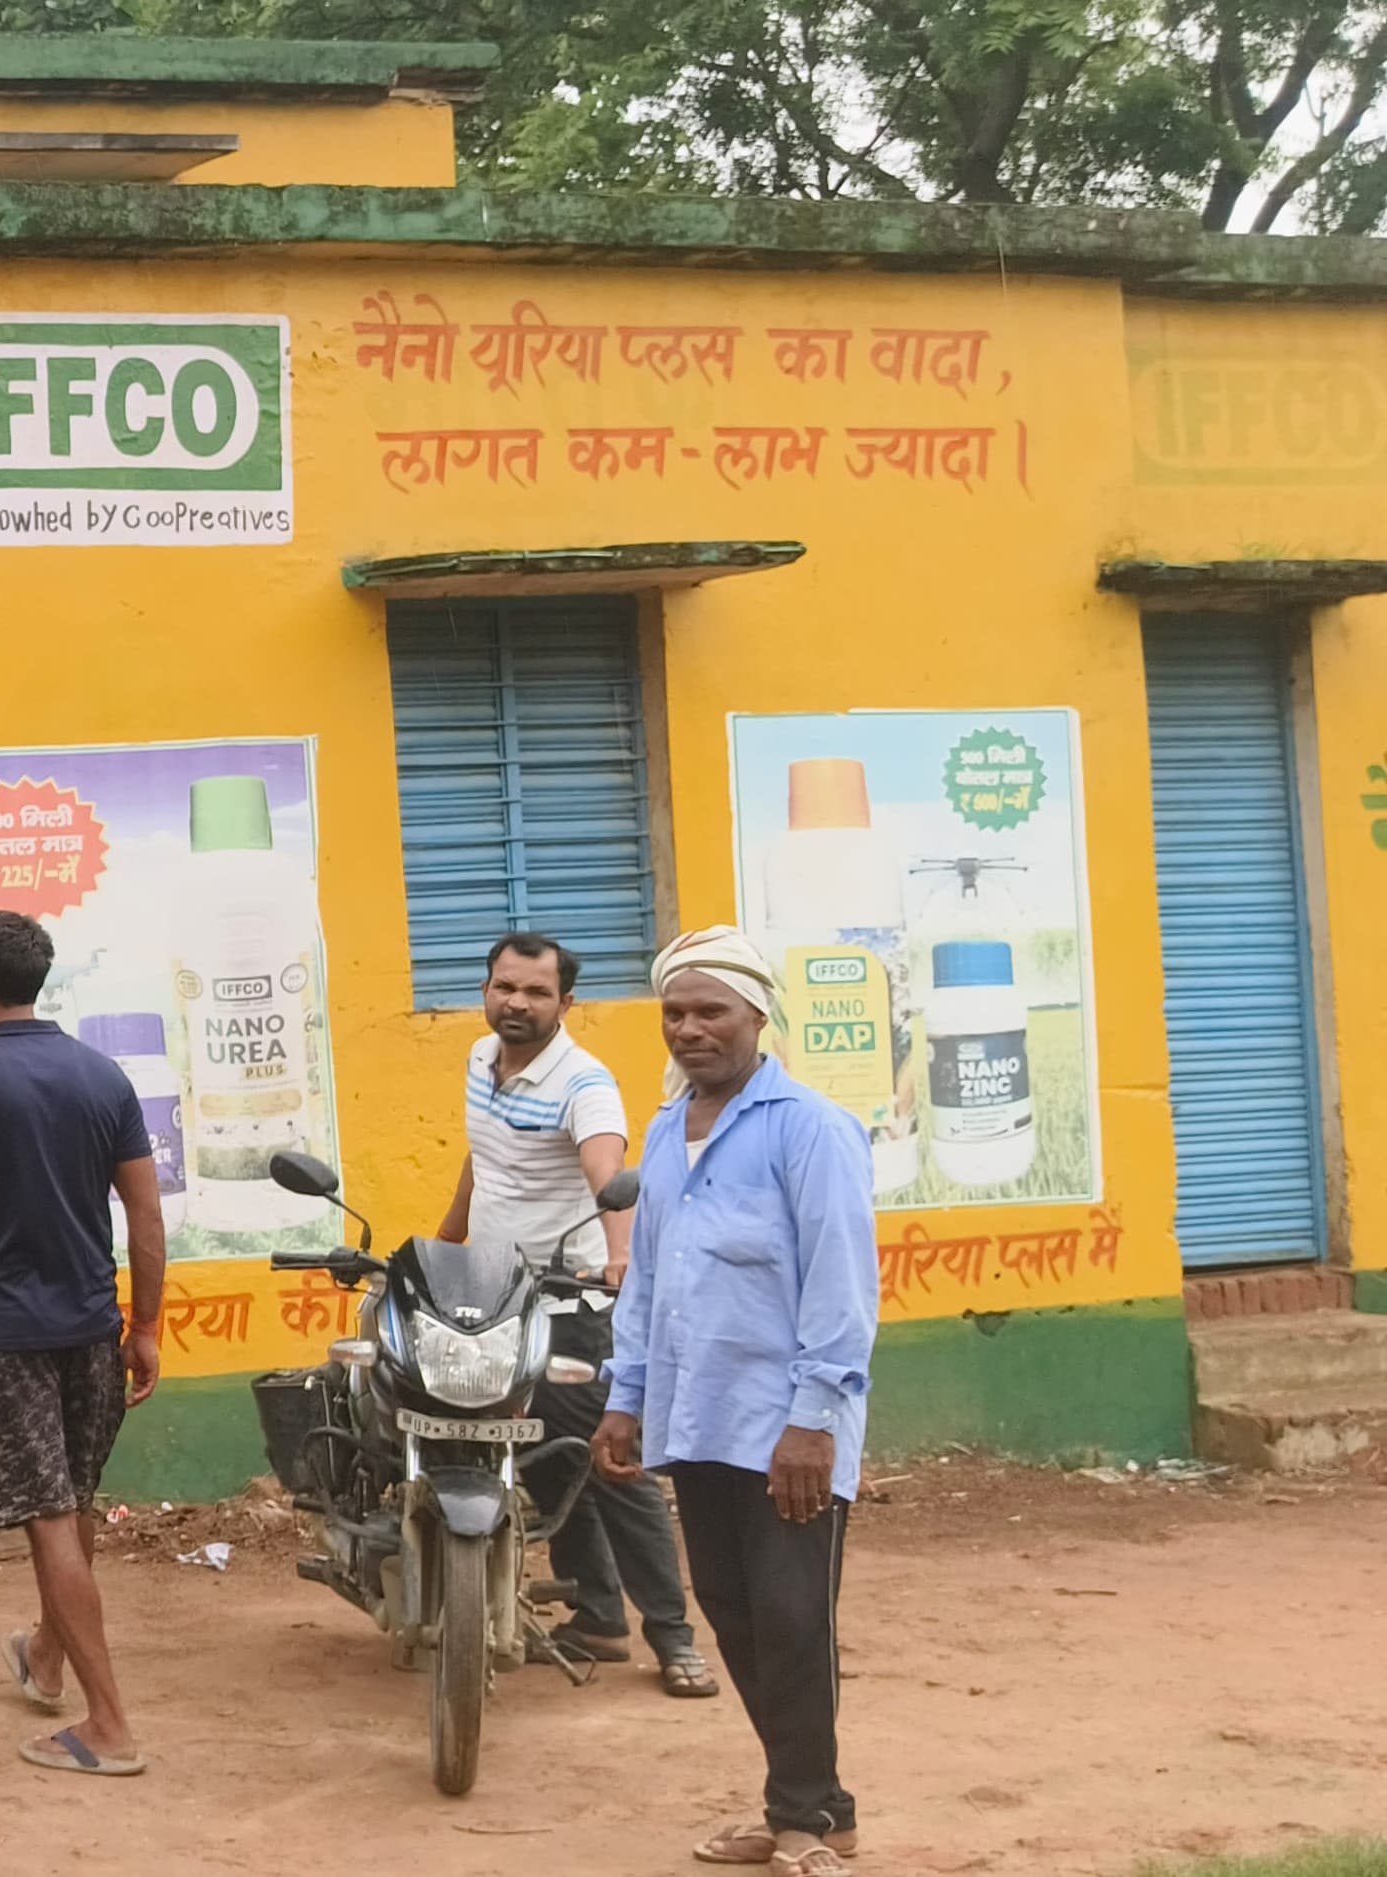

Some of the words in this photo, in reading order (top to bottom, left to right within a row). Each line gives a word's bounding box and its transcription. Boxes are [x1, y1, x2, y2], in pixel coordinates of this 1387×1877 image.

[354, 289, 460, 384] नैनो
[470, 300, 609, 399] यूरिया
[616, 322, 745, 390] प्लस
[767, 326, 853, 384] का
[376, 428, 544, 495] लागत
[845, 426, 996, 495] ज्यादा
[20, 804, 74, 828] मिली
[41, 834, 84, 853] मात्र
[815, 963, 859, 978] IFFCO
[221, 982, 263, 996] IFFCO
[812, 999, 865, 1018] NANO
[205, 1014, 285, 1037] NANO
[807, 1024, 872, 1051] DAP
[206, 1039, 287, 1064] UREA
[245, 1063, 284, 1079] PLUS
[958, 1057, 1020, 1079] NANO
[960, 1076, 1012, 1097] ZINC
[996, 1228, 1083, 1289] प्लस
[1089, 1203, 1124, 1275] में
[455, 1306, 482, 1319] TVS
